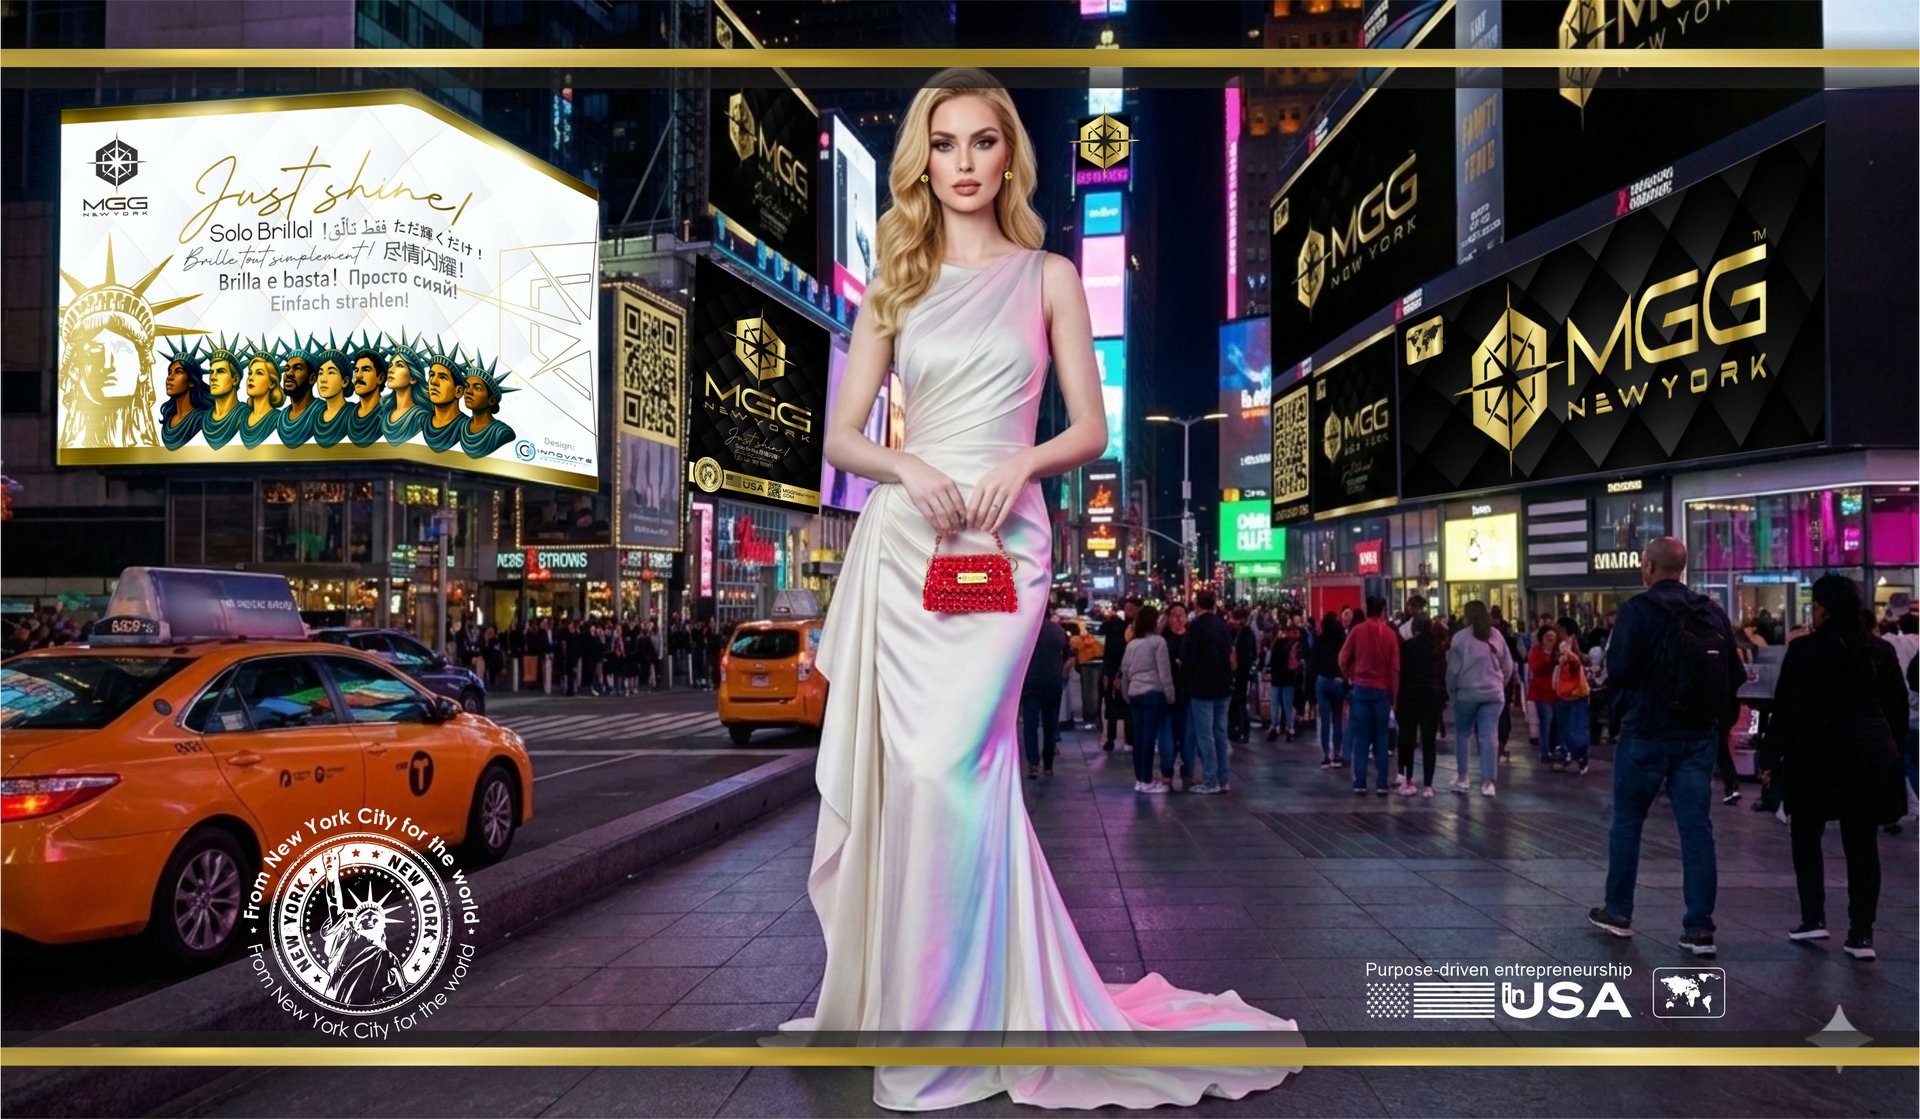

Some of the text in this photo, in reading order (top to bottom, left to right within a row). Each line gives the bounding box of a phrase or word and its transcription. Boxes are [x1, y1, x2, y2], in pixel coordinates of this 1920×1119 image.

[760, 122, 808, 200] MGG
[83, 196, 148, 211] MGG
[179, 146, 473, 244] Just shine!
[1331, 152, 1418, 269] MGG
[210, 220, 312, 242] Solo Brilla!
[1369, 214, 1417, 259] YORK
[183, 246, 238, 271] Brille
[239, 245, 275, 269] tout
[219, 268, 337, 291] Brilla e basta!
[349, 269, 458, 300] Просто сияй!
[271, 292, 409, 312] Einfach strahlen!
[1567, 243, 1767, 386] MGG
[705, 371, 812, 433] MGG
[754, 416, 810, 443] YORK
[1344, 398, 1389, 440] MGG
[544, 437, 575, 451] Design:
[743, 480, 764, 493] USA
[413, 758, 428, 791] T
